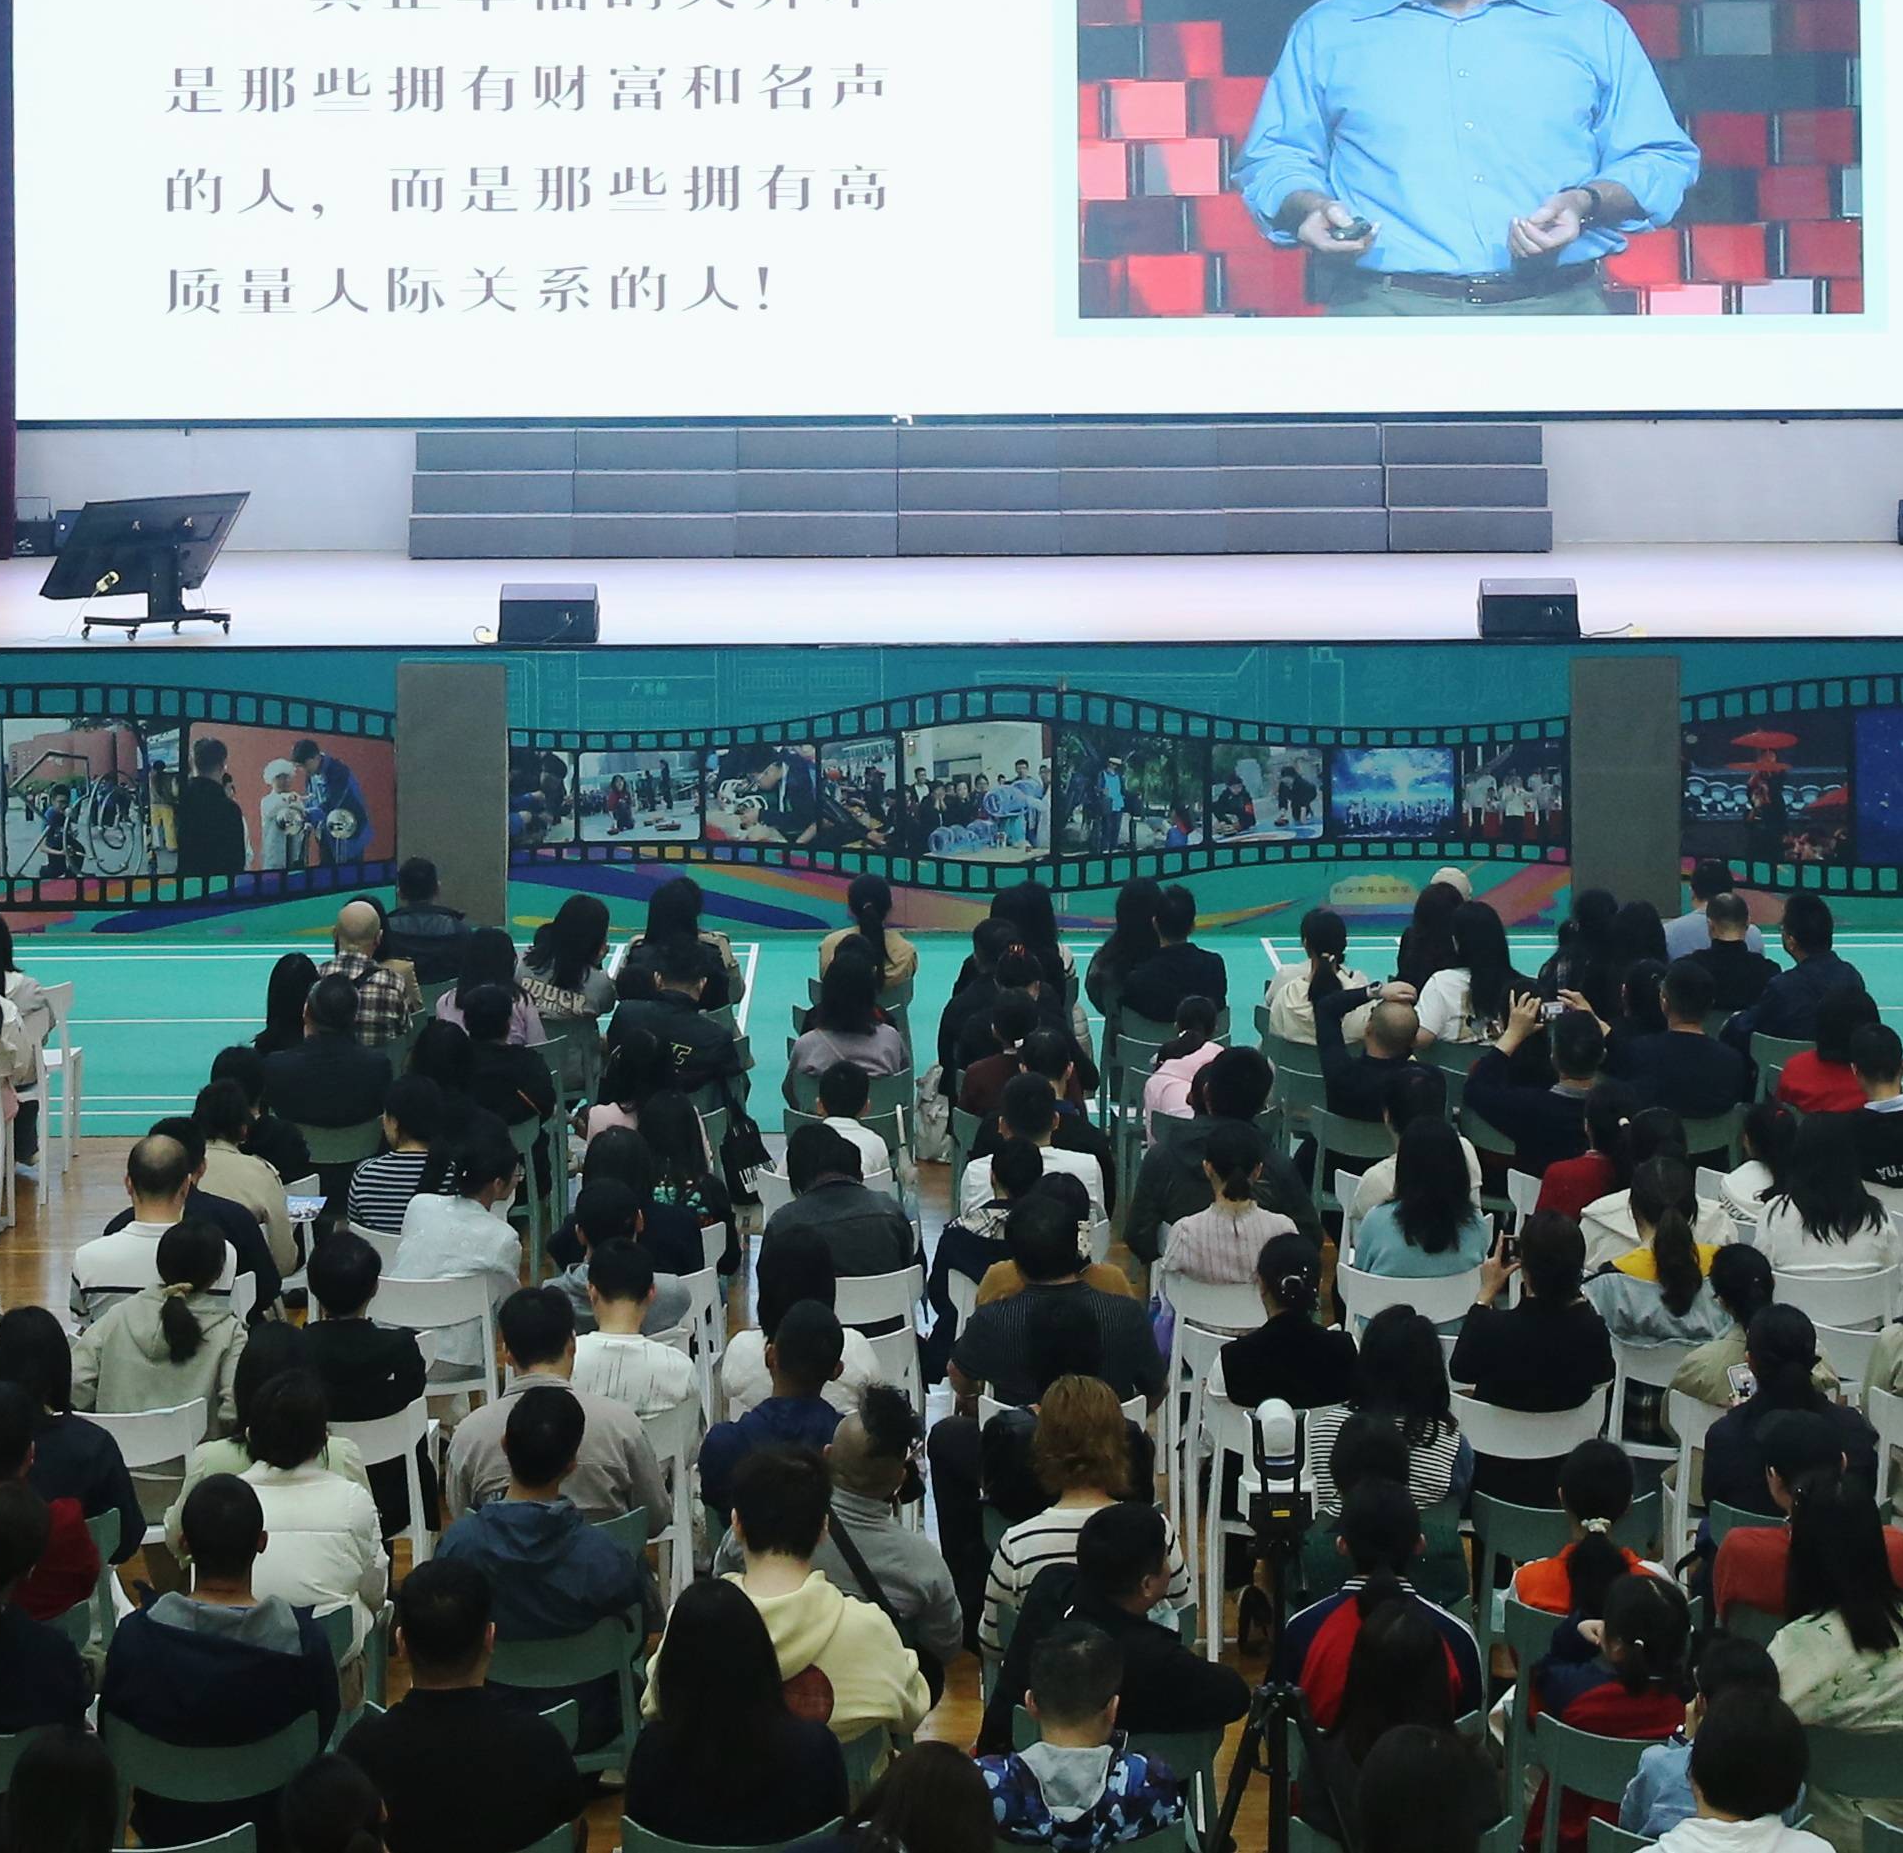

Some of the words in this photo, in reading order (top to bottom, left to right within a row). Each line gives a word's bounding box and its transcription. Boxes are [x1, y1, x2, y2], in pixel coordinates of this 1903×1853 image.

[164, 63, 887, 114] 是那些拥有财富和名声
[165, 164, 887, 220] 的人，而是那些拥有高
[166, 265, 770, 315] 质量人际关系的人！
